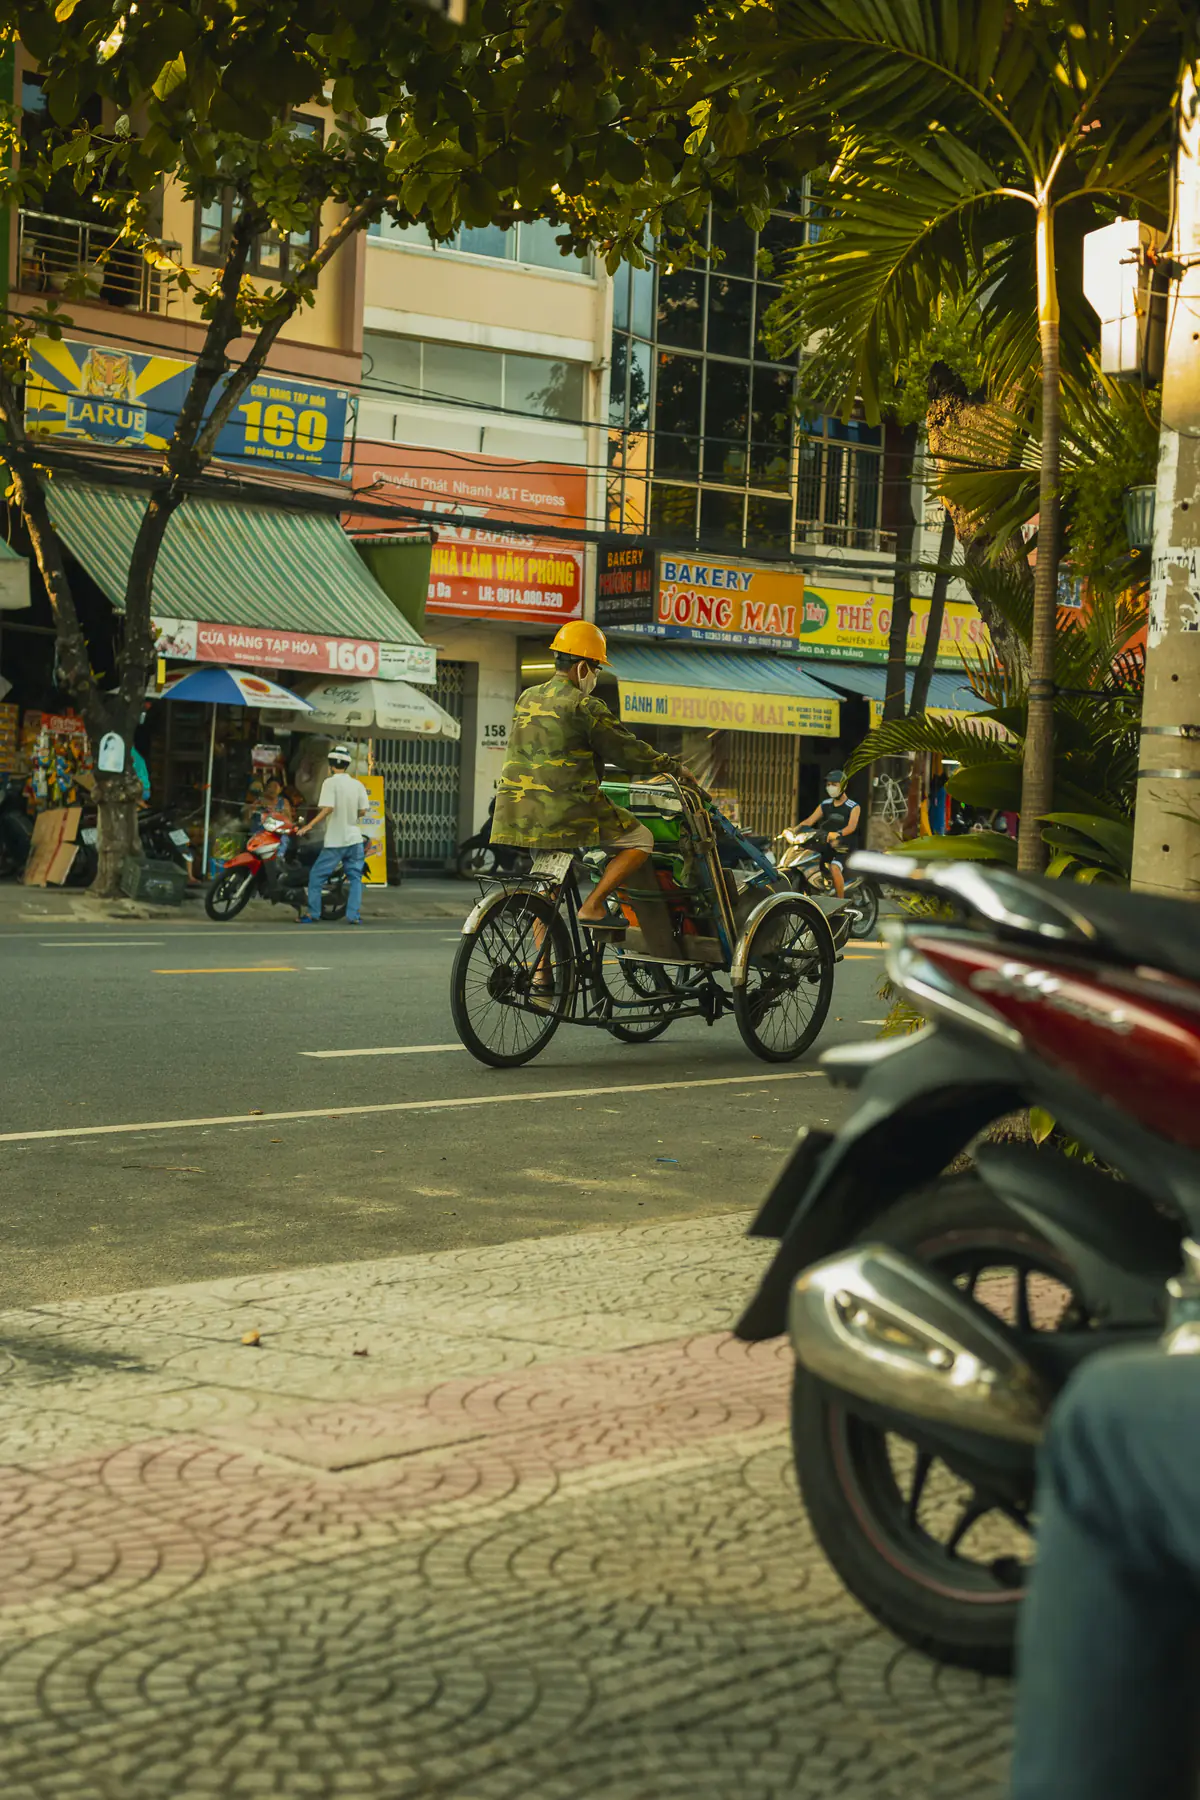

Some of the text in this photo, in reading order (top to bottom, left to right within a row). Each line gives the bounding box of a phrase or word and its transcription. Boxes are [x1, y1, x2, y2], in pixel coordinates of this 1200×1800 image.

[68, 401, 146, 432] LARUE
[238, 401, 328, 452] 160
[421, 476, 448, 492] Phát
[453, 481, 492, 499] Nhanh
[496, 486, 518, 500] J&T
[519, 488, 565, 507] Express
[475, 529, 534, 547] EXPRESS
[431, 545, 458, 576] NHÀ
[462, 547, 492, 579] LÀM
[496, 551, 524, 583] VĂN
[607, 549, 644, 568] BAKERY
[664, 562, 754, 592] BAKERY
[478, 586, 495, 602] LH:
[659, 584, 733, 629] ƯƠNG
[741, 600, 796, 636] MAI
[836, 595, 873, 633] THẾ
[228, 632, 263, 650] HÀNG
[265, 637, 289, 655] TẠP
[325, 641, 375, 672] 160
[752, 702, 784, 726] MAI
[485, 725, 506, 737] 158
